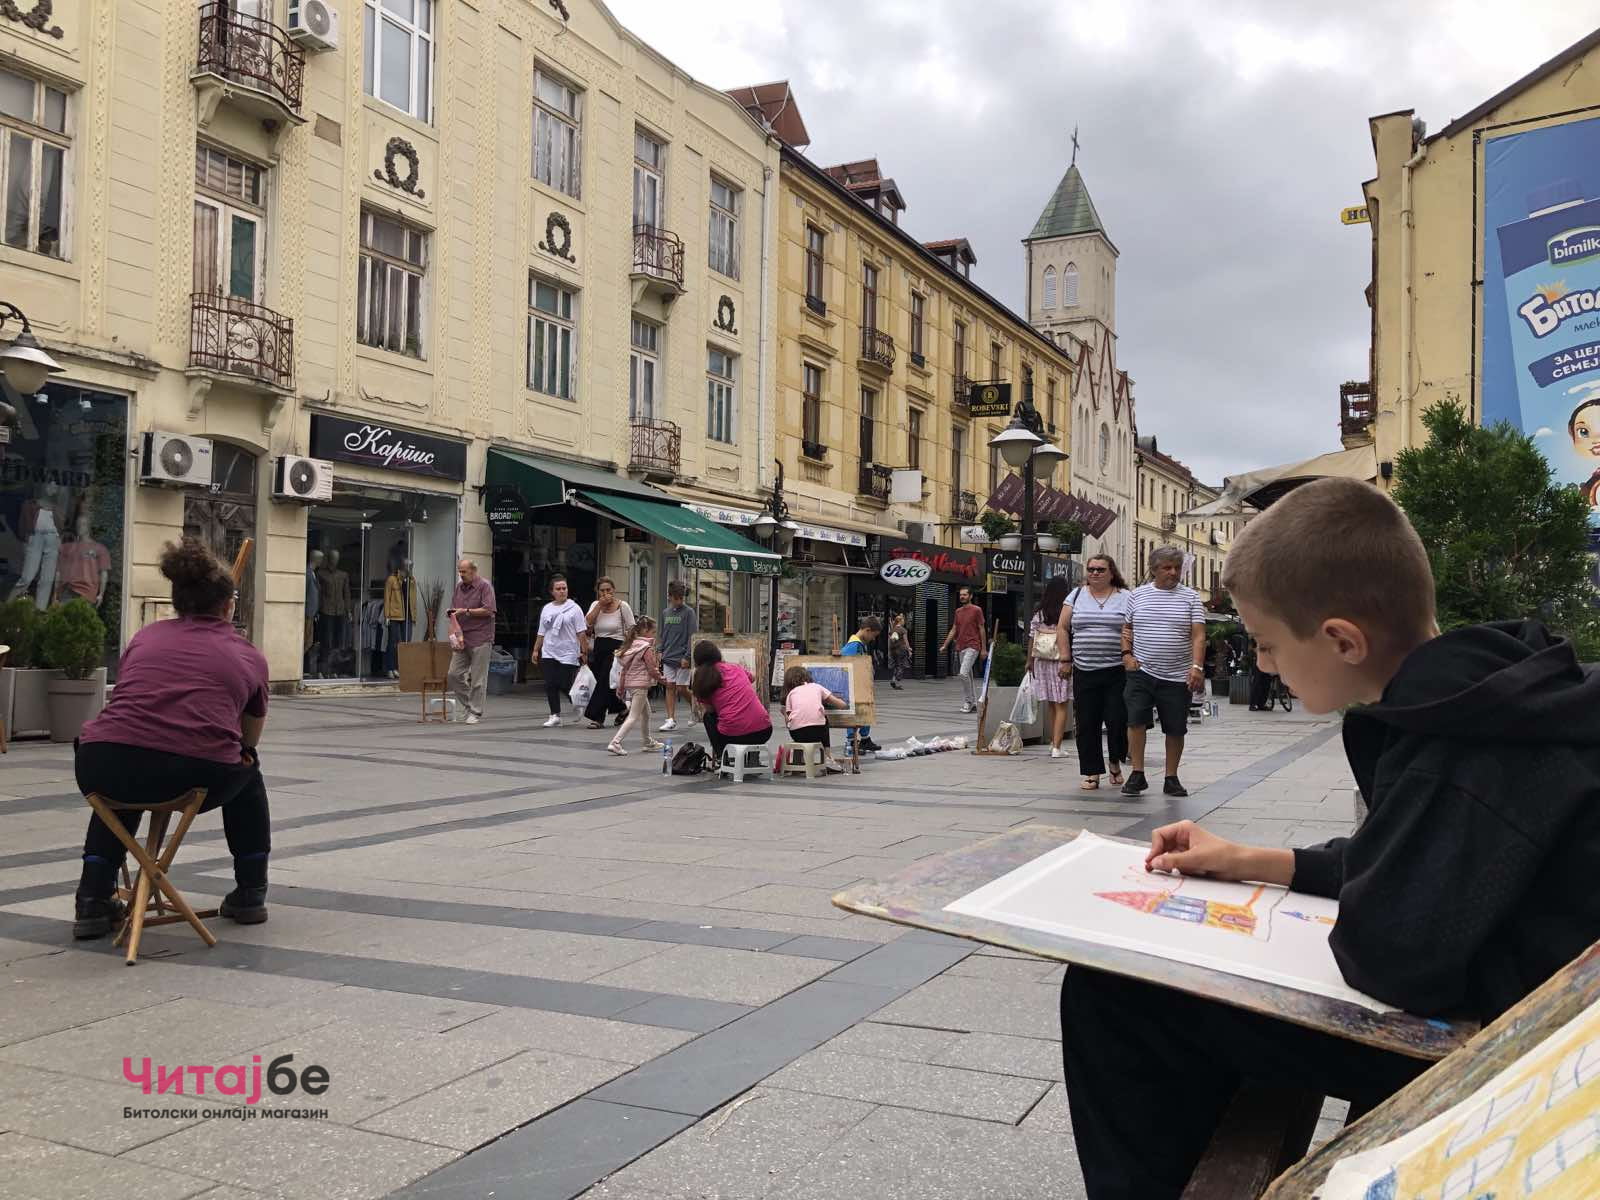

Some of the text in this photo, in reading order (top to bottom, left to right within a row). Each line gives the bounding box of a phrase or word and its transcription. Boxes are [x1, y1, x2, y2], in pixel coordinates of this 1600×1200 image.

[1554, 237, 1600, 260] bimilk
[1553, 353, 1573, 366] ЗА
[884, 563, 927, 578] Peko
[992, 553, 1036, 572] Casin
